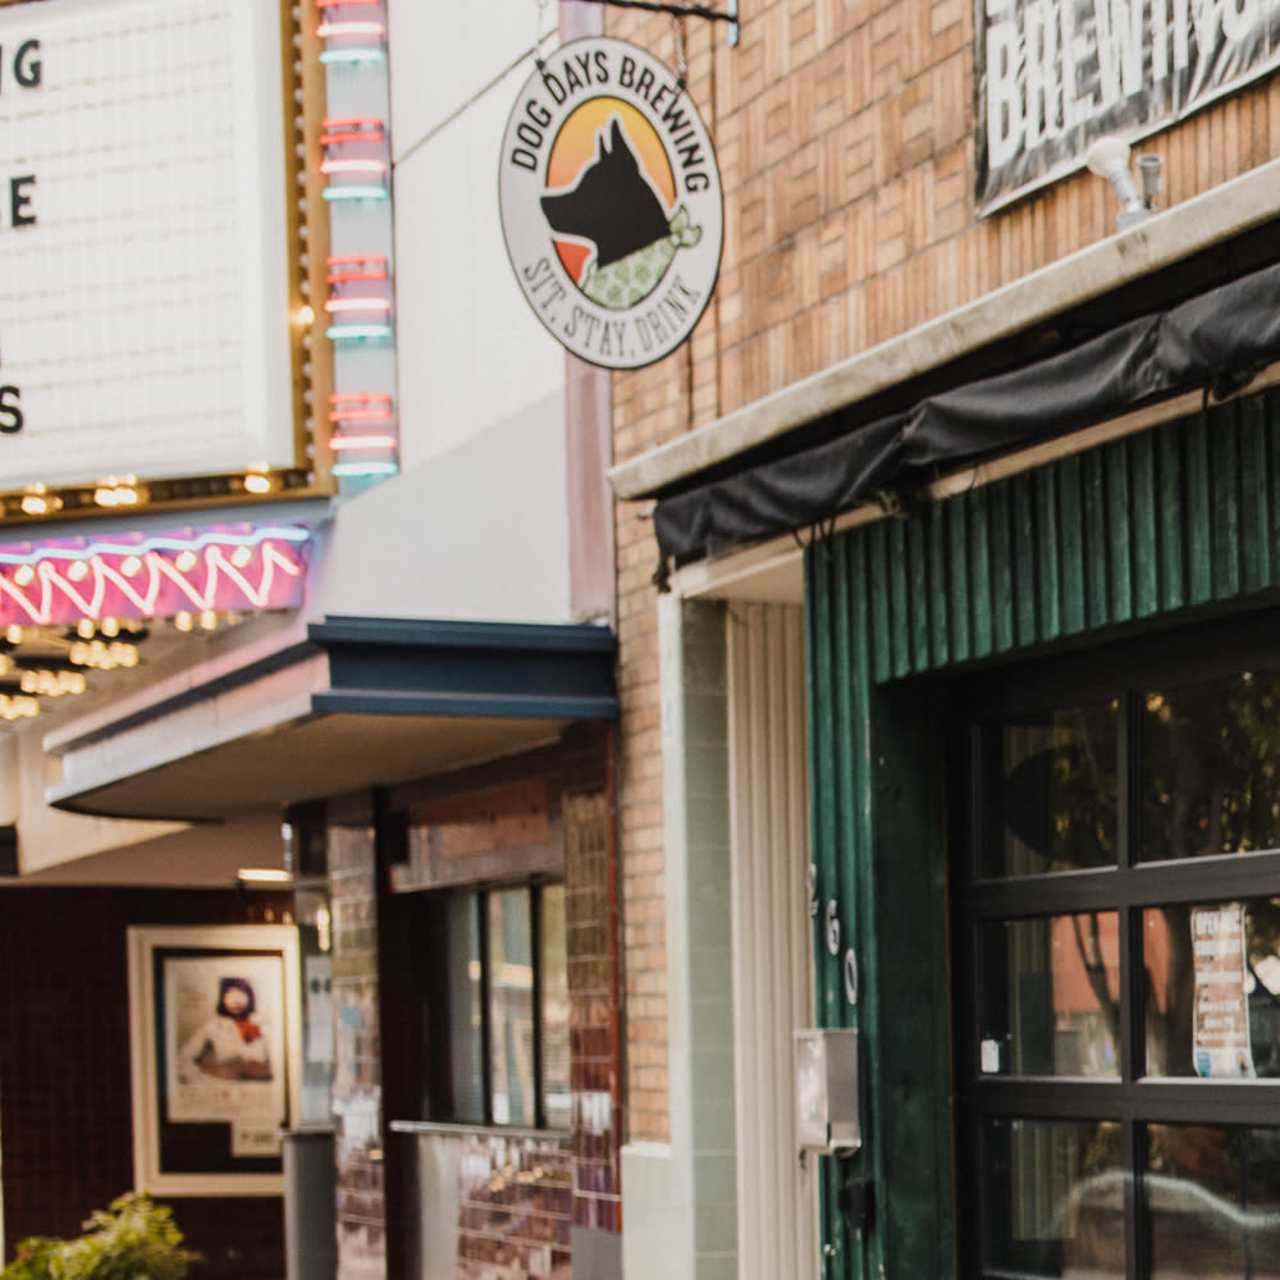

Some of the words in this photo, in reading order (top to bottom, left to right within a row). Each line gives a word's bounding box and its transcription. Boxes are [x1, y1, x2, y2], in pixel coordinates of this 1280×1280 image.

[511, 99, 553, 172] DOG
[543, 51, 609, 105] DAYS
[619, 56, 710, 193] BREWING
[634, 275, 701, 352] DRINK
